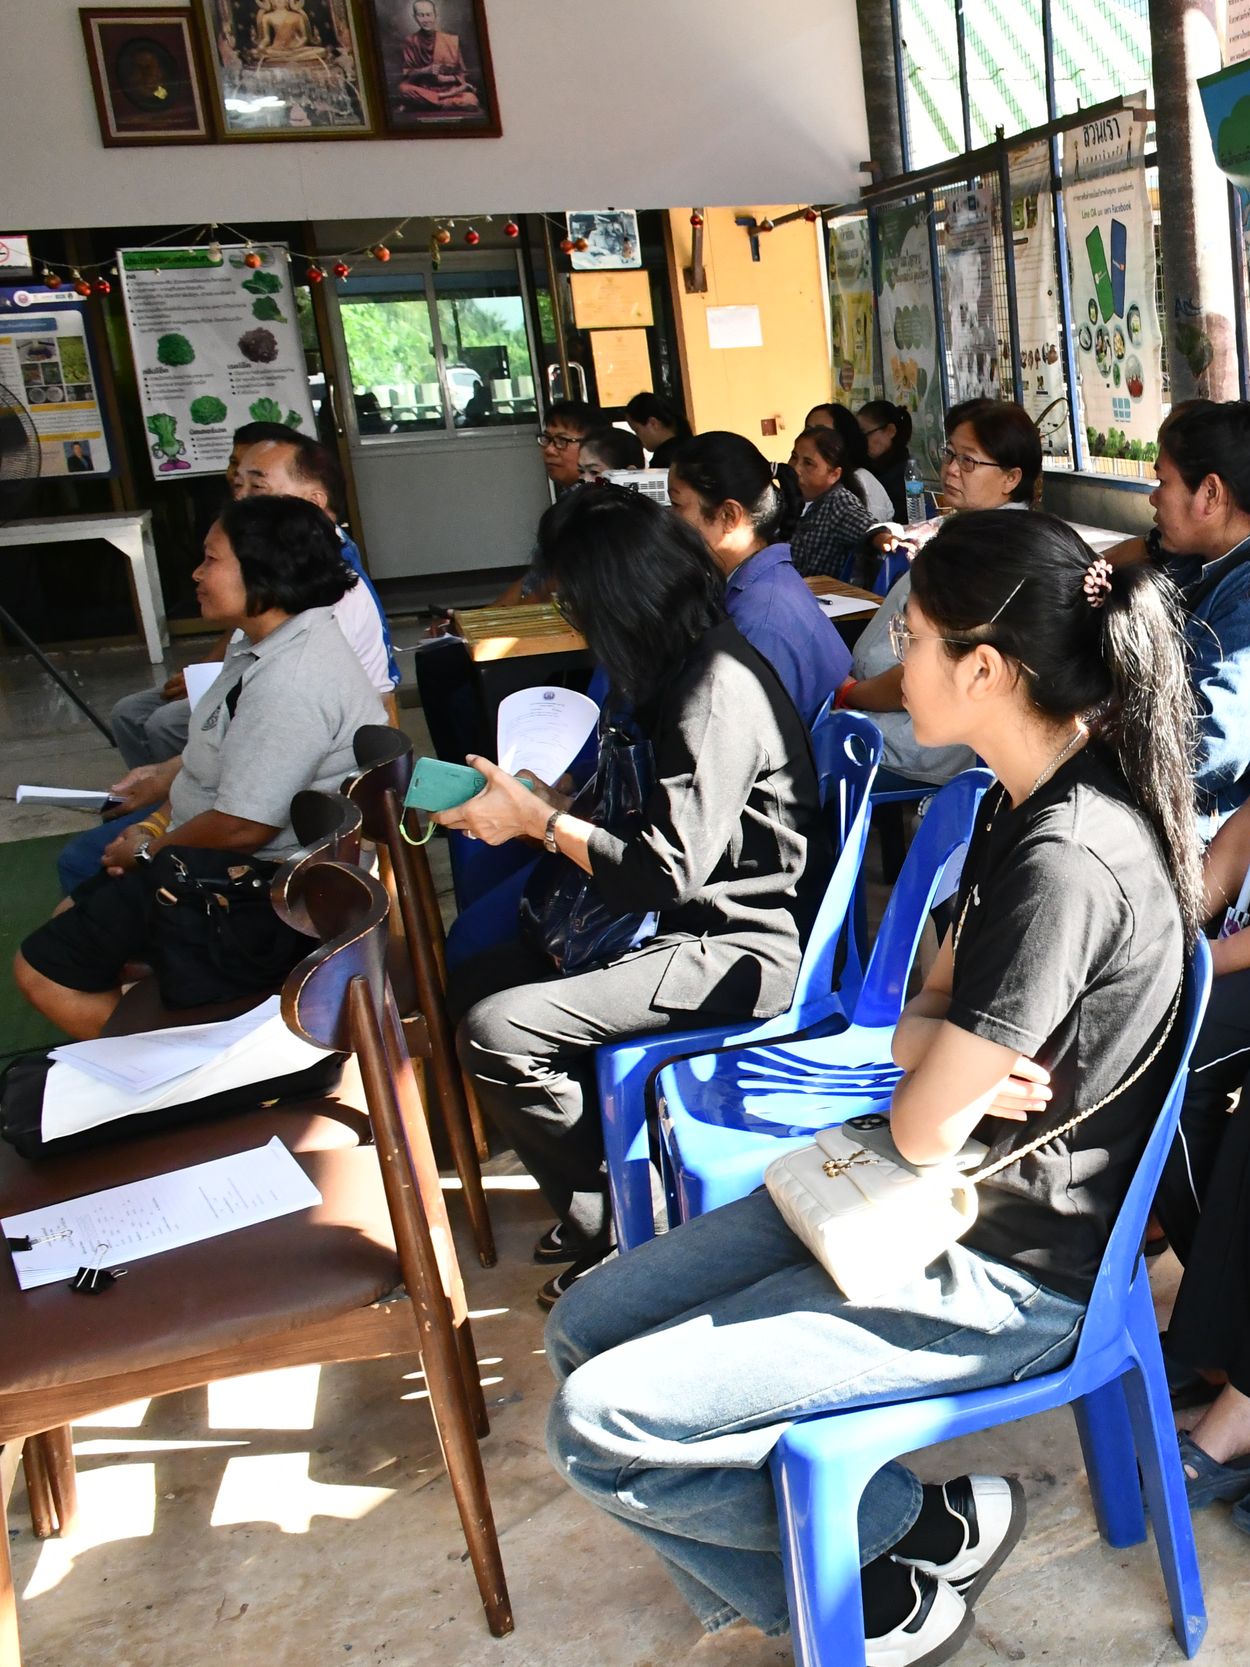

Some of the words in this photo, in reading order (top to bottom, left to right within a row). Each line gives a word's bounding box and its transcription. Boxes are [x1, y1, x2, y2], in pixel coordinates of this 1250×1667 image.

[1083, 117, 1121, 148] สวนเรา
[1111, 202, 1132, 215] Facebook
